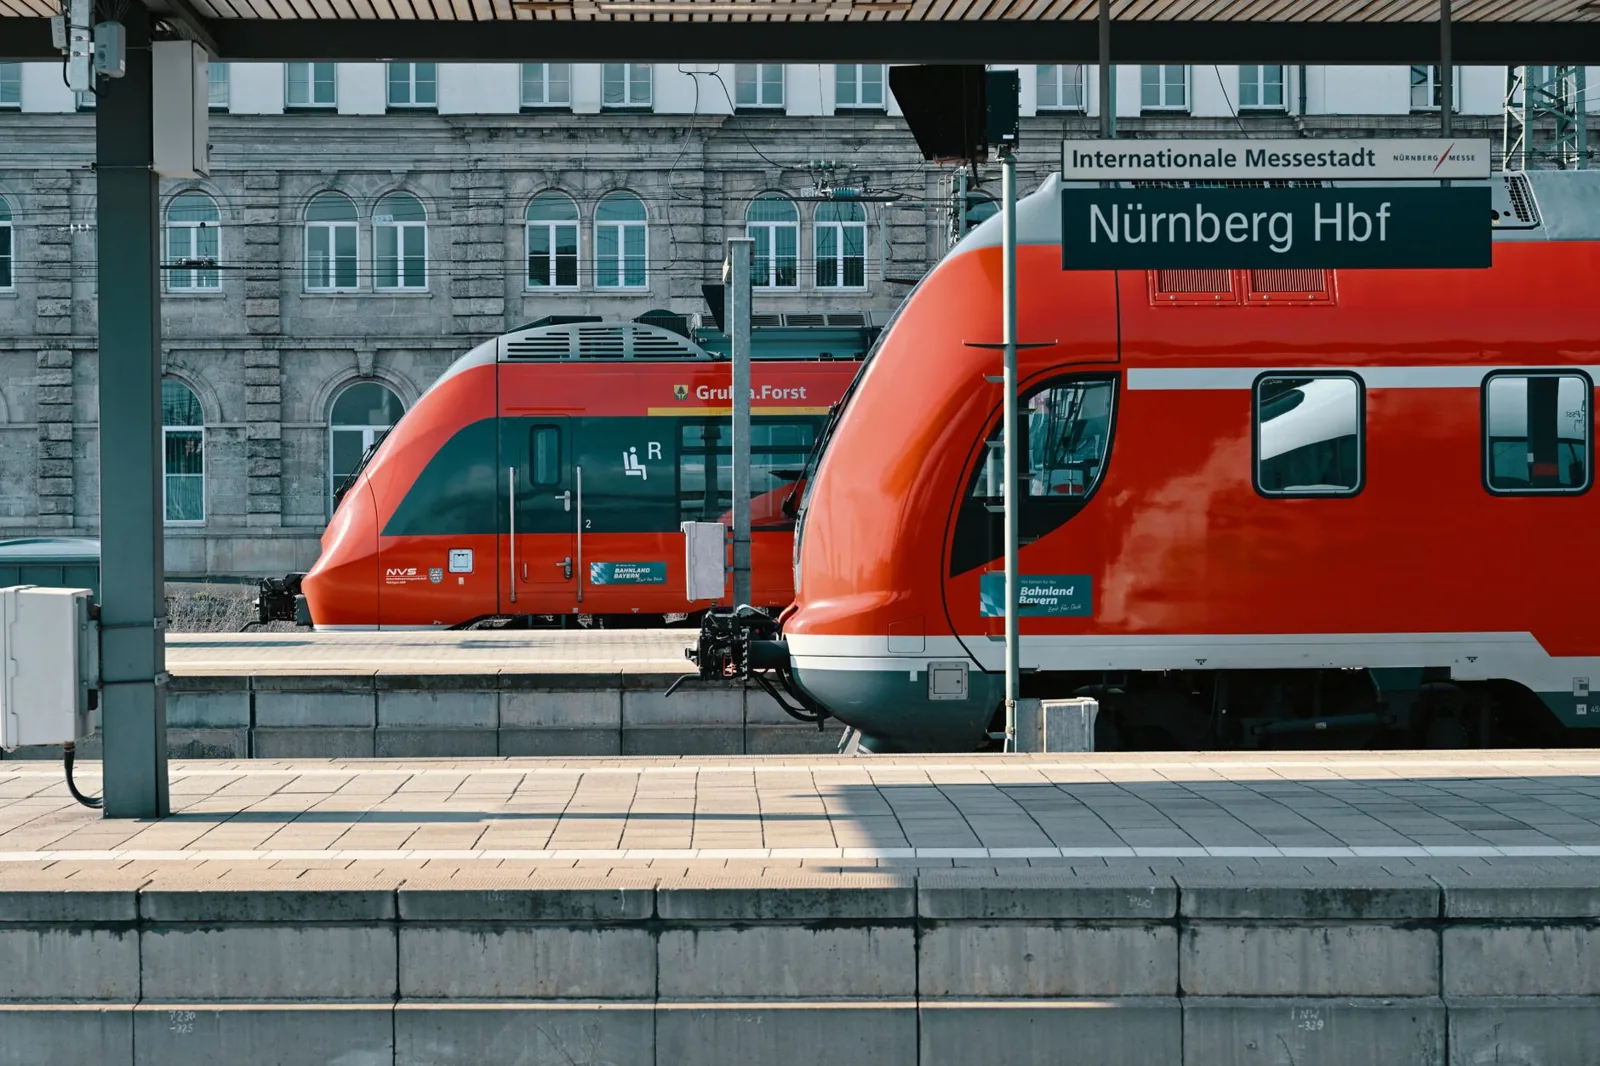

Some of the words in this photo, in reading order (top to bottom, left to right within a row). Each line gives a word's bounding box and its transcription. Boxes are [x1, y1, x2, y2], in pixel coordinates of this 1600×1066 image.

[1072, 148, 1237, 168] Internationale
[1245, 147, 1376, 168] Messestadt
[1393, 153, 1439, 161] NÜRNBERG
[1090, 203, 1293, 253] Nürnberg
[1315, 201, 1391, 242] Hbf
[696, 385, 734, 400] Gru
[648, 442, 662, 460] R
[585, 519, 592, 529] 2
[386, 568, 417, 576] NVS
[1020, 586, 1074, 596] Bahnland
[1019, 596, 1058, 605] Bayern
